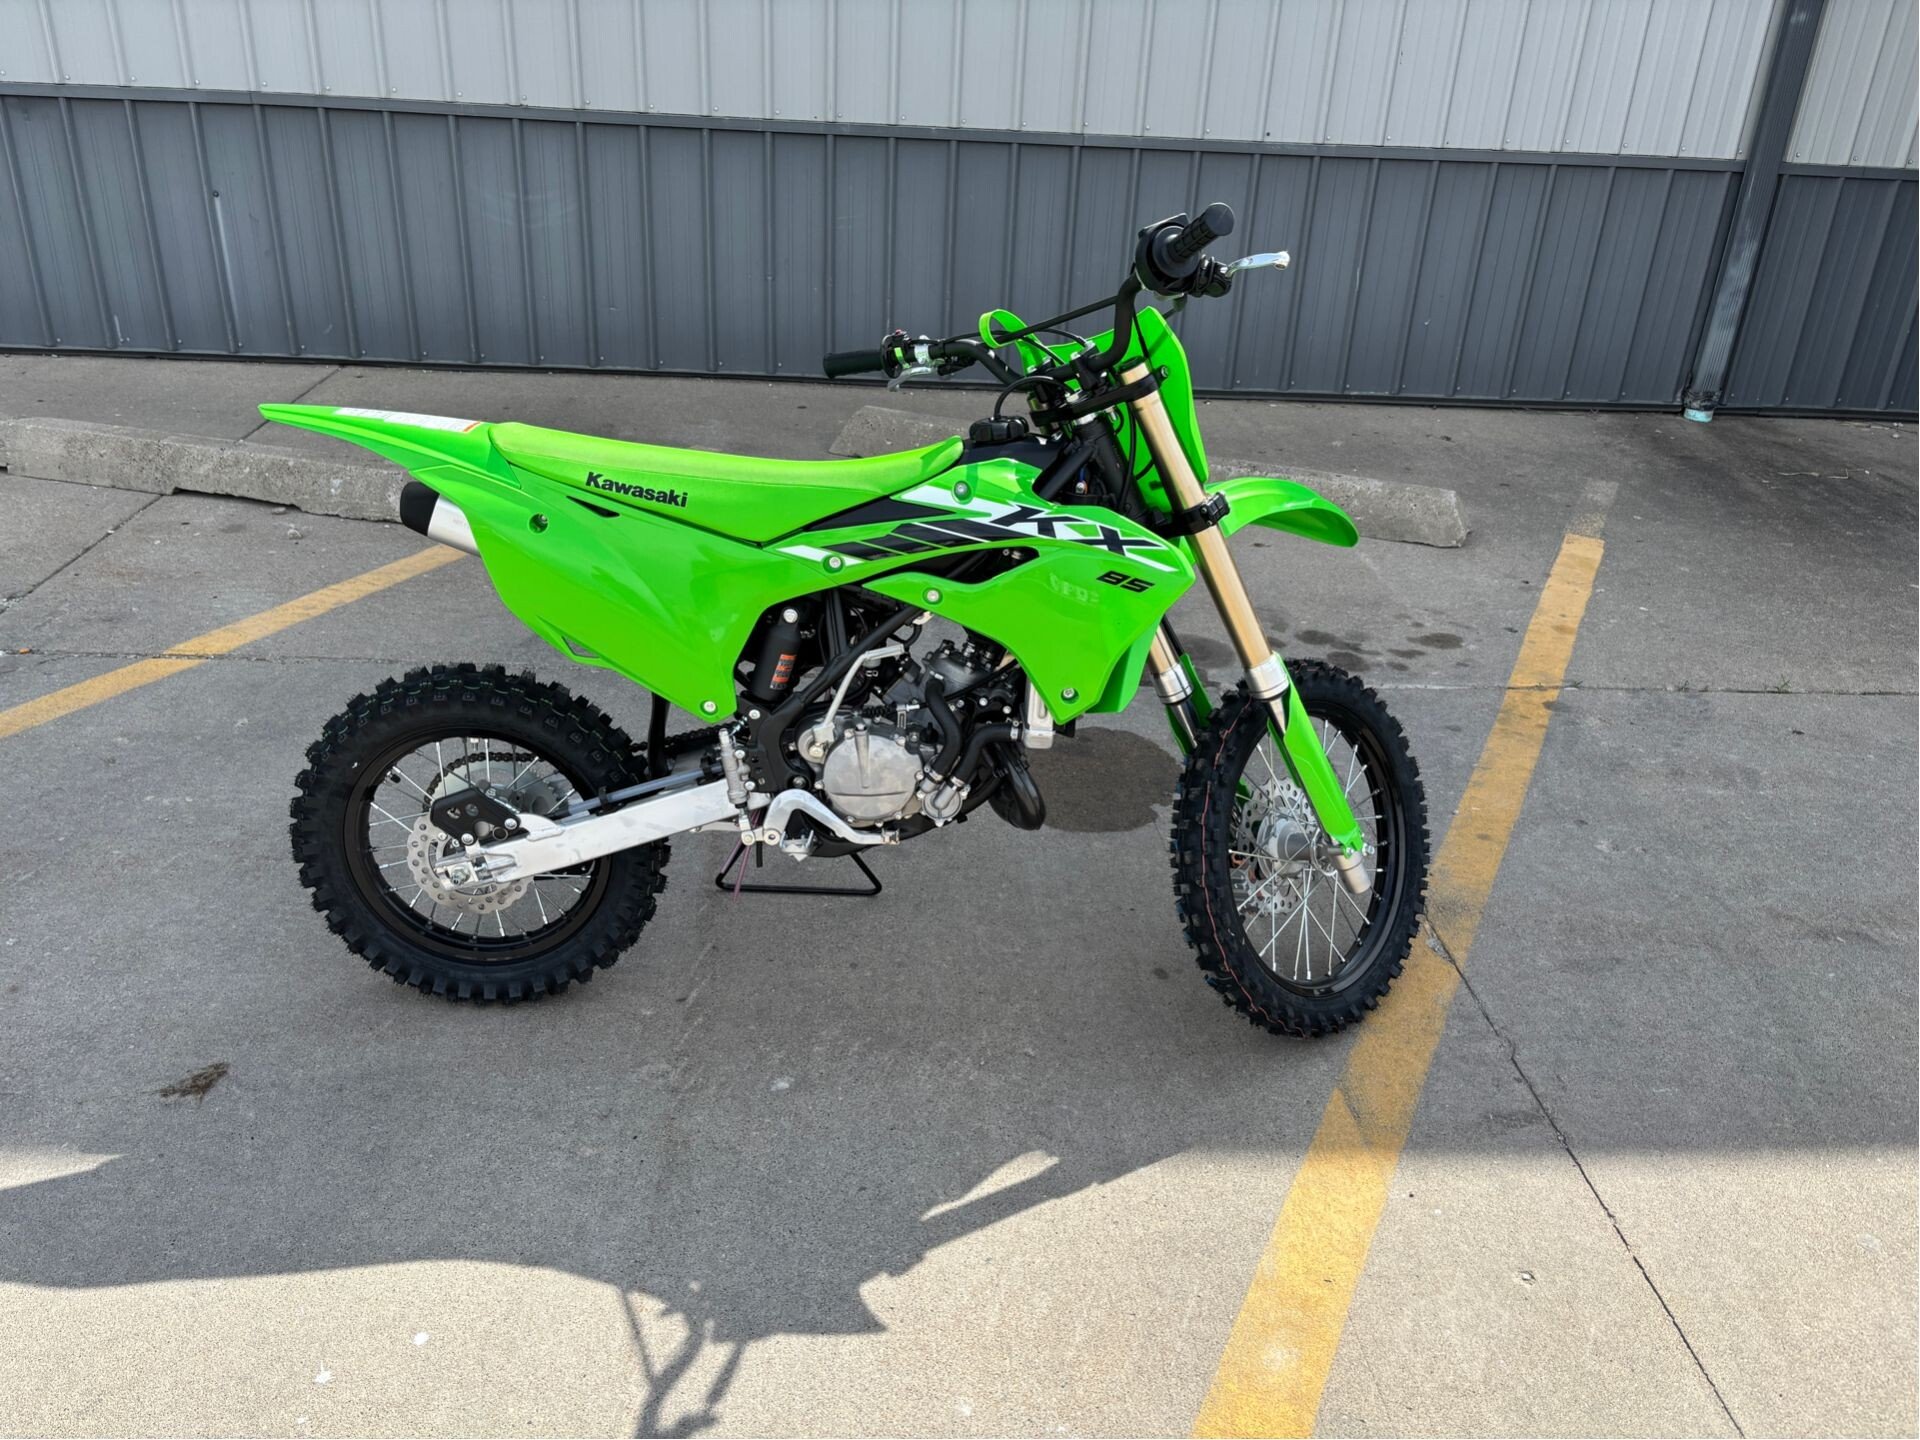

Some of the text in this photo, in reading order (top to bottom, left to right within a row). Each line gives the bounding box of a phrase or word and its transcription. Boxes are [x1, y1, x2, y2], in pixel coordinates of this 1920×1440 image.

[585, 471, 688, 508] Kawasaki
[989, 504, 1163, 557] KX
[1096, 570, 1155, 593] 85
